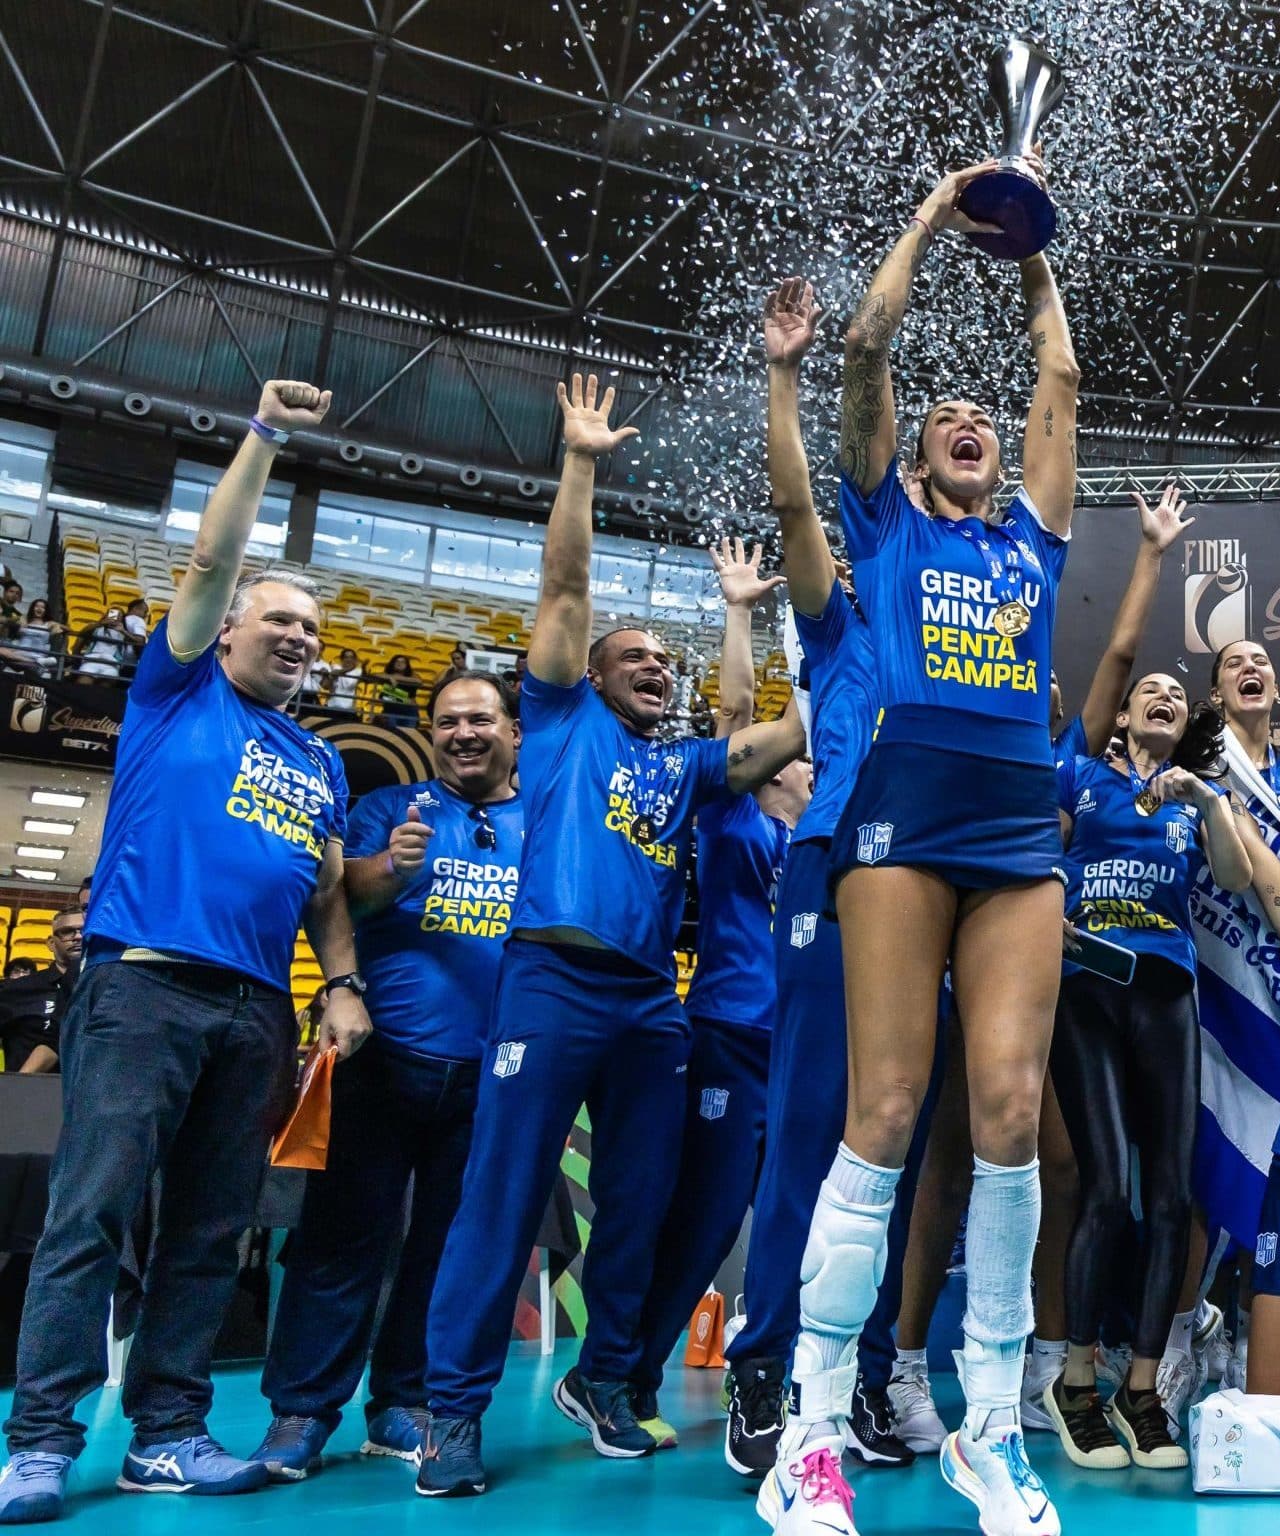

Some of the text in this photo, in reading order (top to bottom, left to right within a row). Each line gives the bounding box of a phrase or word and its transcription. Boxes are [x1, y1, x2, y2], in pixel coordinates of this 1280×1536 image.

[1184, 539, 1247, 575] FINAL
[921, 569, 1040, 607] GERU
[922, 624, 1017, 661] PENTA
[925, 652, 1038, 694] CAMPEÃ
[604, 811, 677, 870] CAPEÃ
[433, 857, 519, 882] GERDA
[1083, 859, 1176, 884] GERDAU
[430, 878, 518, 902] MINAS
[1081, 879, 1155, 899] MINAS
[424, 896, 511, 921] PENTA
[420, 913, 508, 938] CAMP
